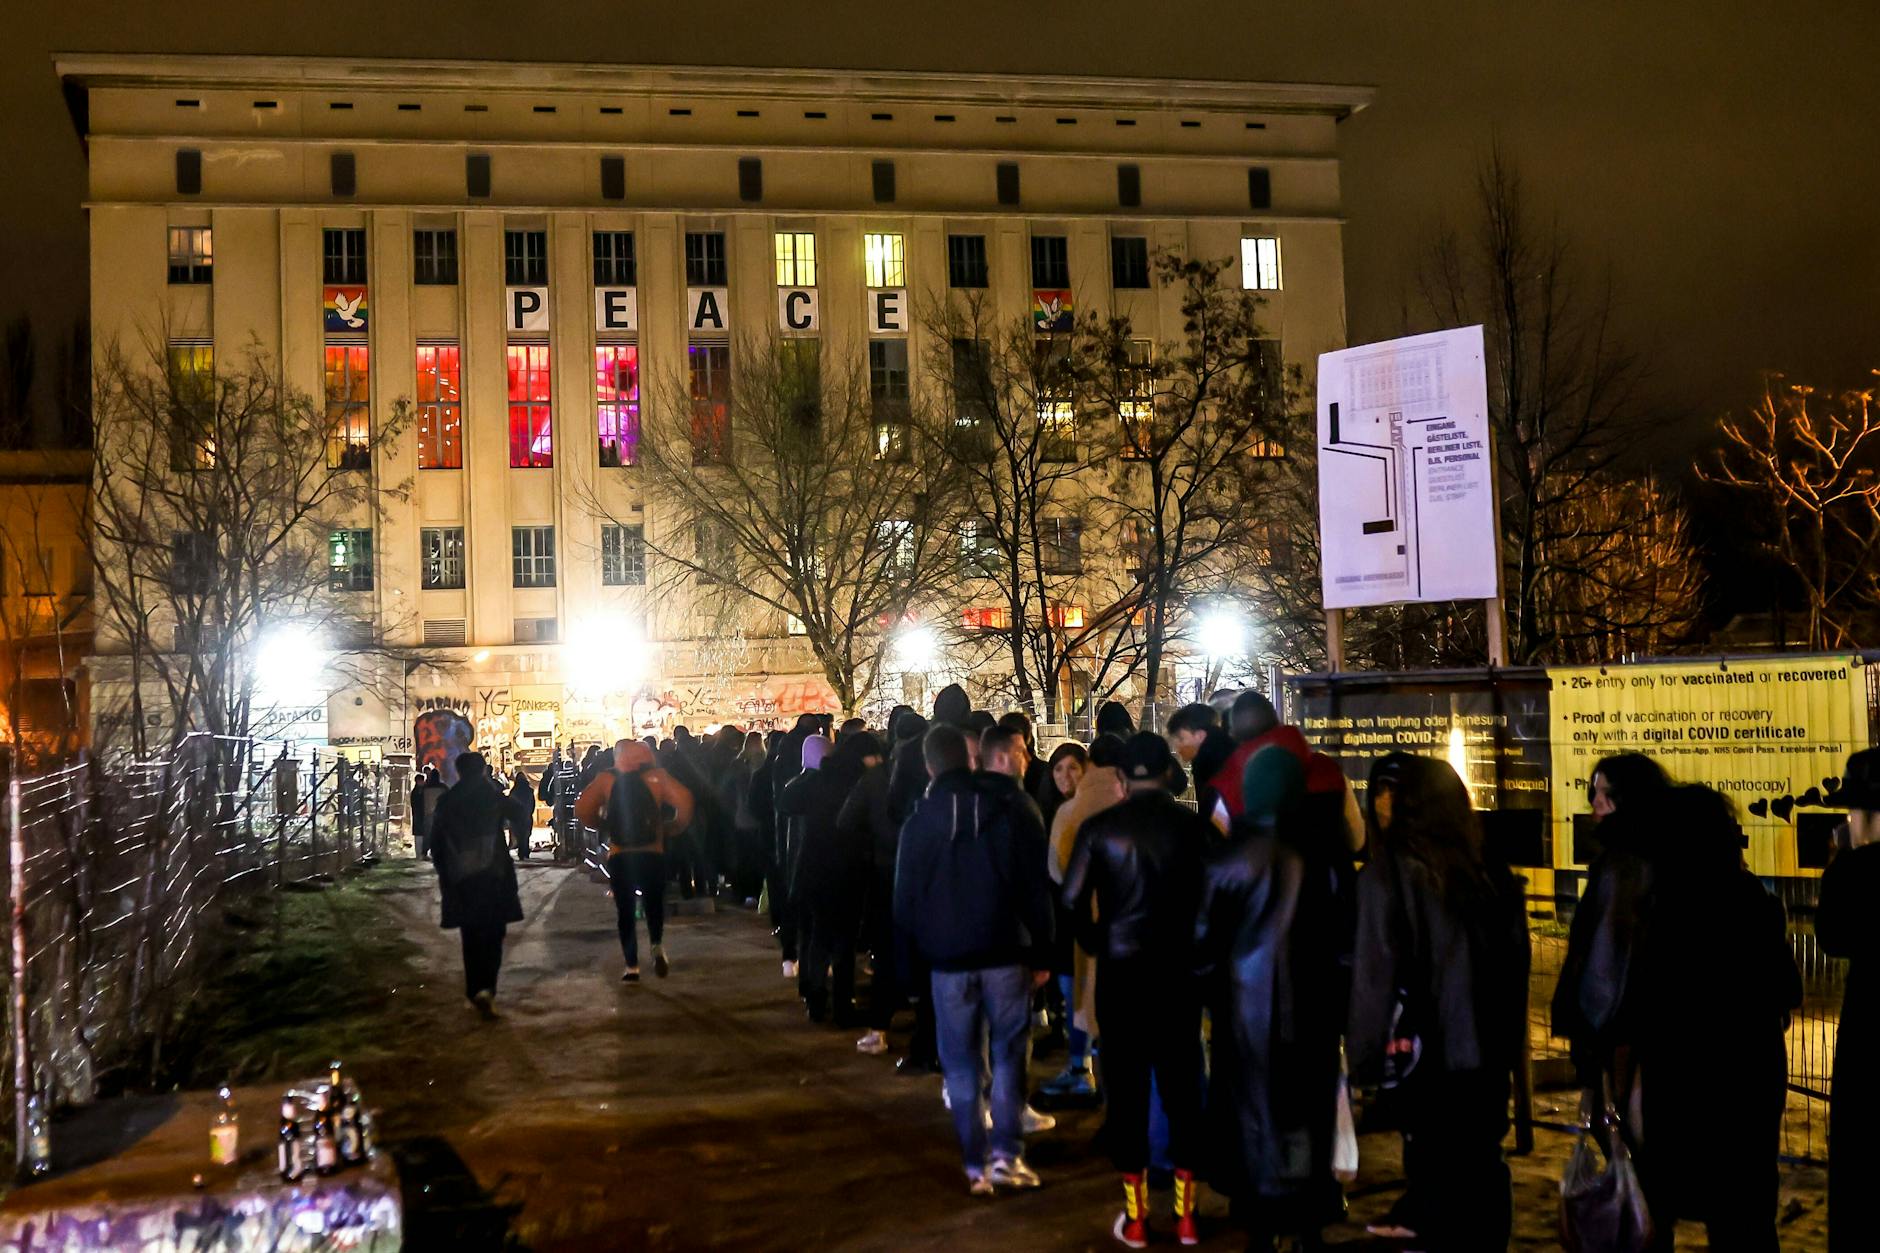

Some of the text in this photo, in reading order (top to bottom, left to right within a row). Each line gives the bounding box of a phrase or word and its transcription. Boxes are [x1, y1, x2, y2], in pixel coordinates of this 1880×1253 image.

[1427, 443, 1460, 453] BERLINER
[1444, 453, 1480, 463] PERSONAL
[1571, 667, 1847, 690] 2G+ entry only for vaccinated or recovered
[479, 689, 510, 716] YG
[1304, 716, 1354, 729] Nachweis
[1356, 718, 1375, 728] von
[1377, 715, 1421, 729] Impfung
[1424, 714, 1448, 727] oder
[1573, 710, 1773, 723] Proof of vaccination or recovery
[1343, 731, 1394, 746] digitalem
[1573, 726, 1805, 744] only with a digital COVID certificate
[1713, 745, 1731, 754] NHS
